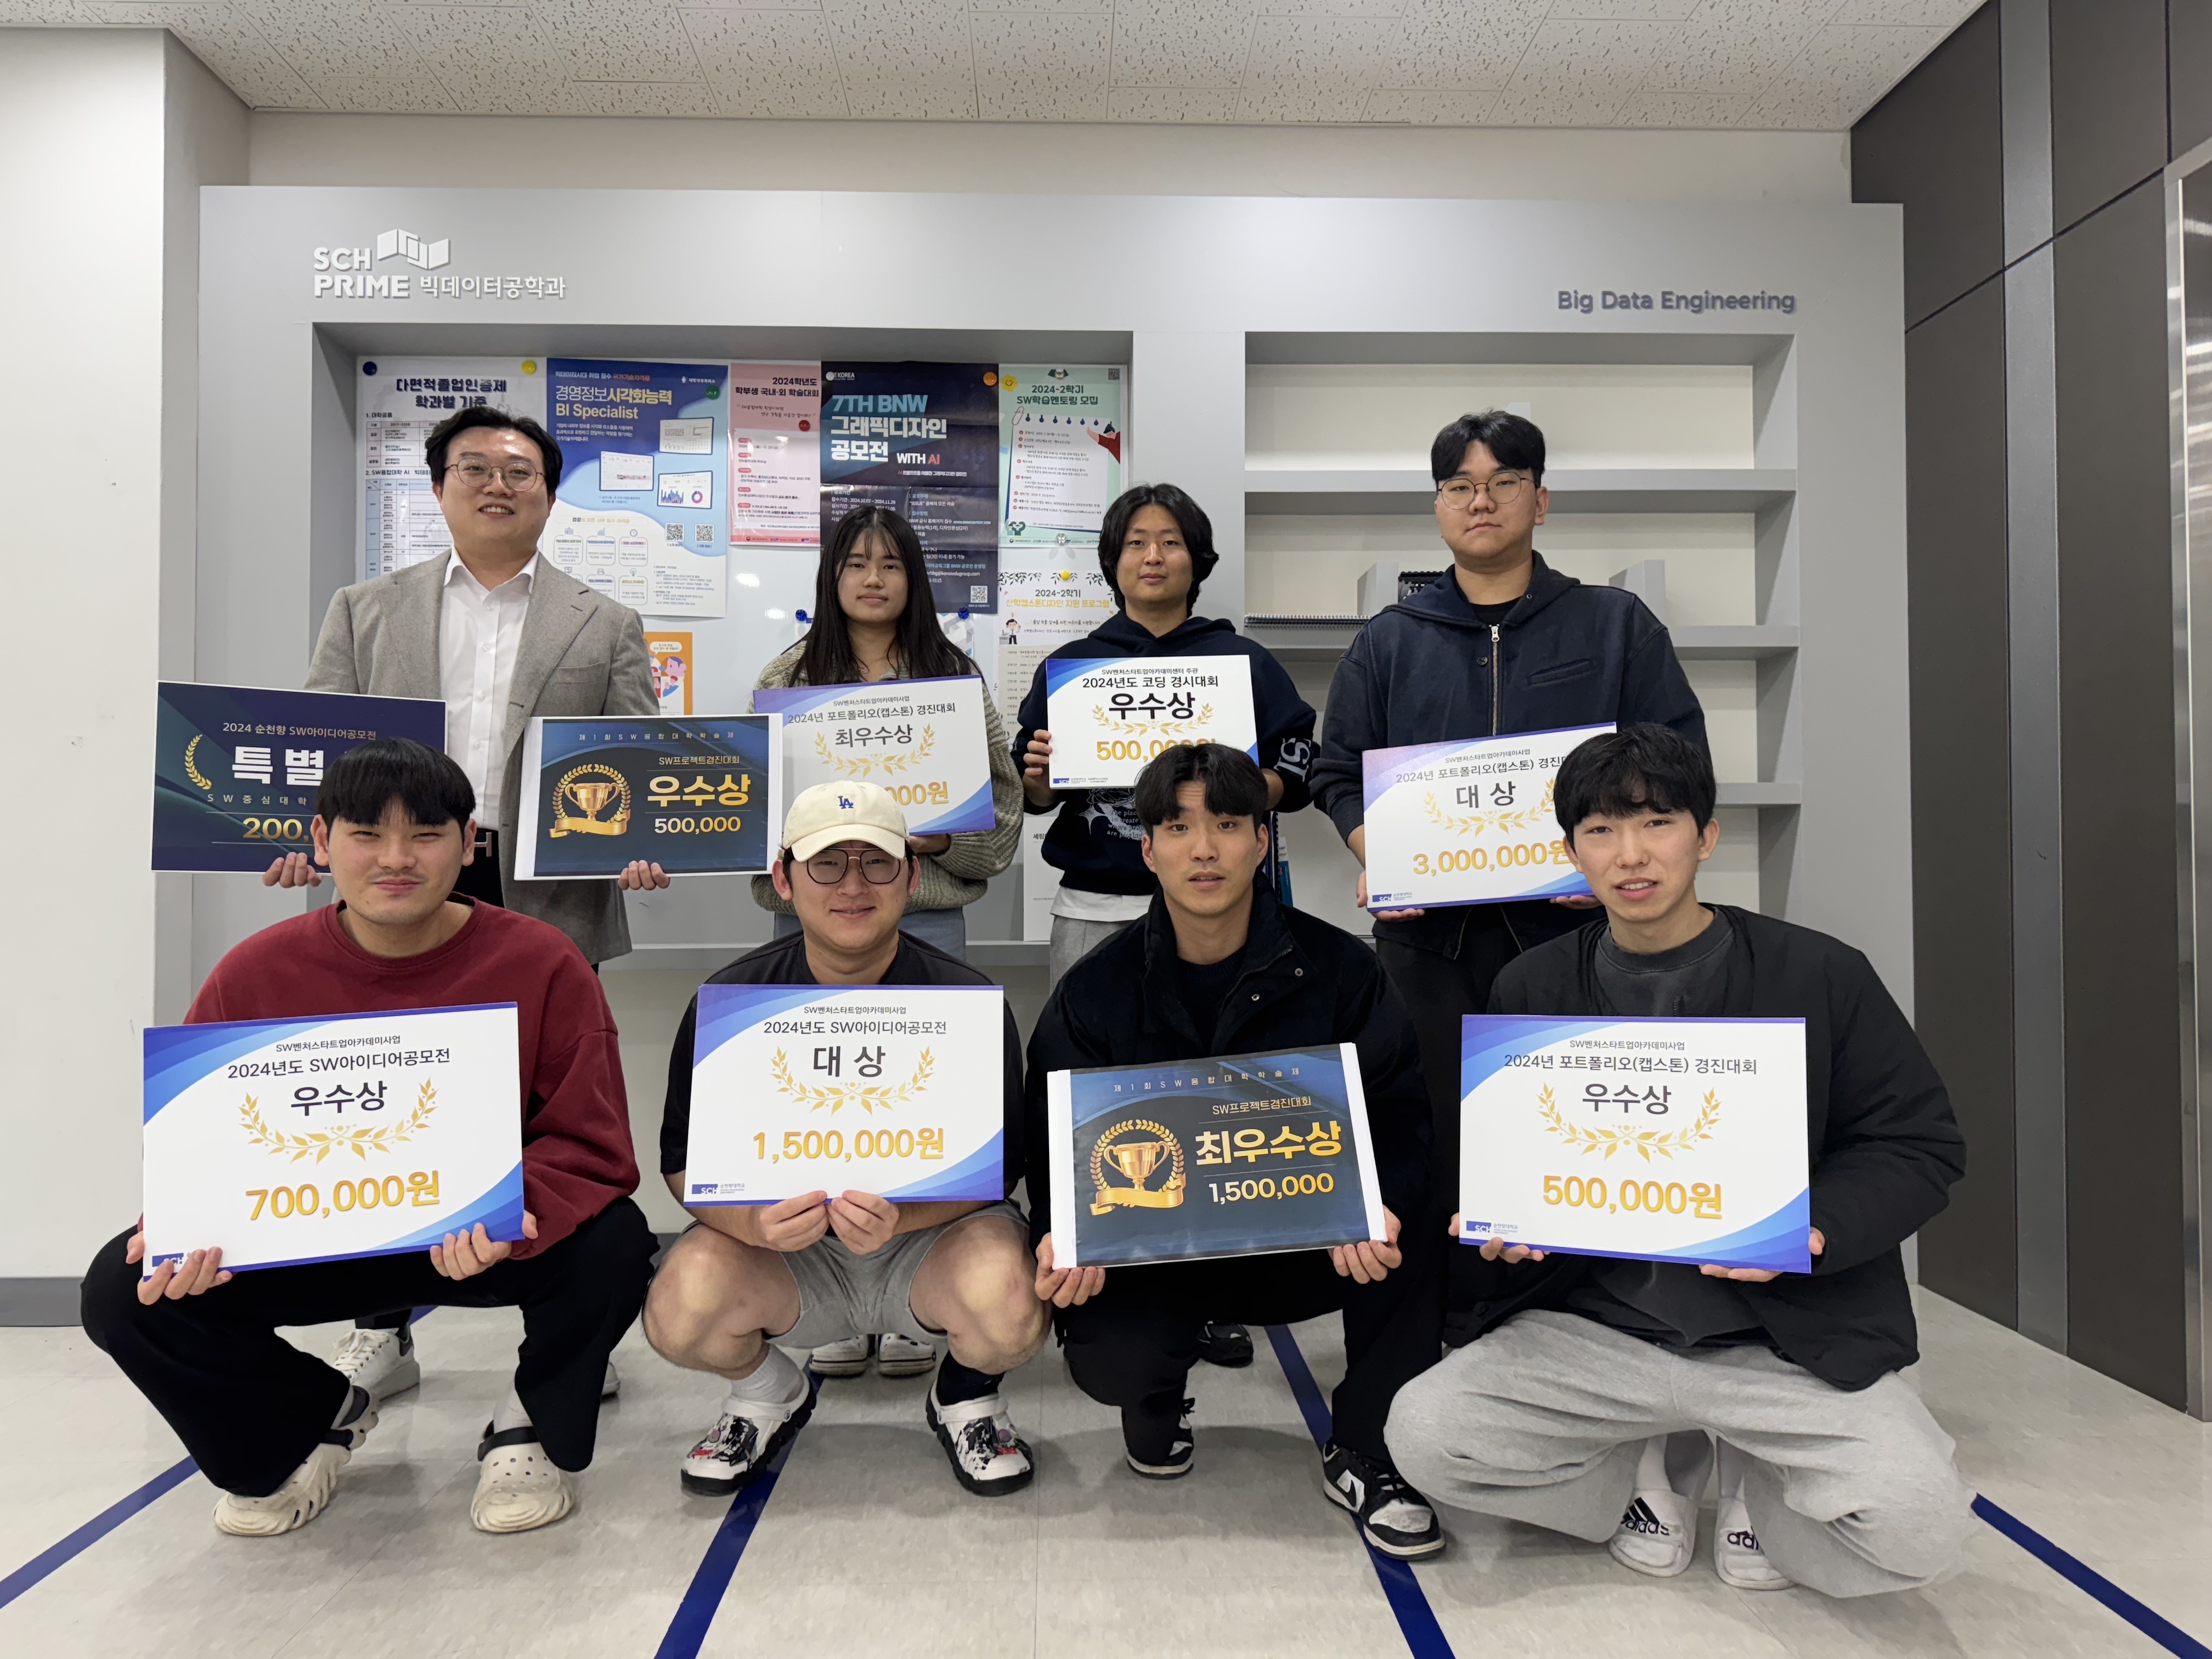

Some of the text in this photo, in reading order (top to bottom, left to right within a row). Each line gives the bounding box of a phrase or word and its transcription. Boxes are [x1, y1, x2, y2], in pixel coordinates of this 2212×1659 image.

[313, 247, 372, 270] SCH
[314, 275, 566, 298] PRIME 빅데이터공학과
[1558, 290, 1796, 314] Big Data Engineering
[396, 379, 507, 392] 다면적졸업인증제
[735, 386, 759, 396] 학부생
[789, 388, 819, 397] 학술대회
[772, 377, 817, 386] 2024학년도
[1031, 385, 1084, 394] 2024-2학기
[415, 395, 487, 409] 학과별 기준
[555, 385, 672, 405] 경영정보시각화능력
[832, 394, 928, 413] 7TH BNW
[1017, 396, 1098, 405] SW학습멘토링 모집
[556, 403, 639, 420] BI Specialist
[831, 416, 947, 439] 그래픽디자인
[831, 439, 889, 462] 공모전
[896, 452, 940, 465] WITH AI
[1035, 589, 1081, 597] 2024-2학기
[1065, 600, 1080, 608] 지원
[1082, 600, 1110, 608] 프로그램
[1082, 675, 1219, 689] 2024년도 코딩 경시대회
[788, 702, 956, 724] 2024년 포트폴리오(캡스톤) 경진대회
[1108, 692, 1196, 720] 우수상
[223, 722, 376, 741] 2024 순천향 SW아이디어공모전
[834, 724, 914, 748] 최우수상
[658, 755, 740, 766] SW프로젝트경진대회
[1096, 738, 1216, 763] 500,0
[232, 746, 325, 787] 특별
[1396, 770, 1434, 783] 2024년
[1437, 759, 1534, 780] 포트폴리오(캡스톤)
[647, 774, 751, 808] 우수상
[838, 795, 854, 809] LA
[654, 816, 741, 835] 500,000
[1413, 839, 1572, 876] 3,000,000원
[803, 1006, 907, 1014] SW벤처스타트업아카데미사업
[763, 1020, 947, 1035] 2024년도 SW아이디어공모전
[275, 1035, 401, 1053] SW벤처스타트업아카데미사업
[1570, 1040, 1686, 1051] SW벤처스타트업아카데미사업
[227, 1048, 451, 1080] 2024년도 SW아이디어공모전
[1504, 1054, 1758, 1075] 2024년 포트폴리오(캡스톤) 경진대회
[290, 1080, 388, 1117] 우수상
[1212, 1095, 1312, 1115] SW프로젝트경진대회
[1582, 1082, 1672, 1115] 우수상
[753, 1127, 944, 1164] 1,500,000원
[1194, 1119, 1342, 1166] 최우수상
[245, 1169, 441, 1221] 700,000원
[1208, 1172, 1335, 1205] 1,500,000
[1542, 1174, 1723, 1220] 500,000원
